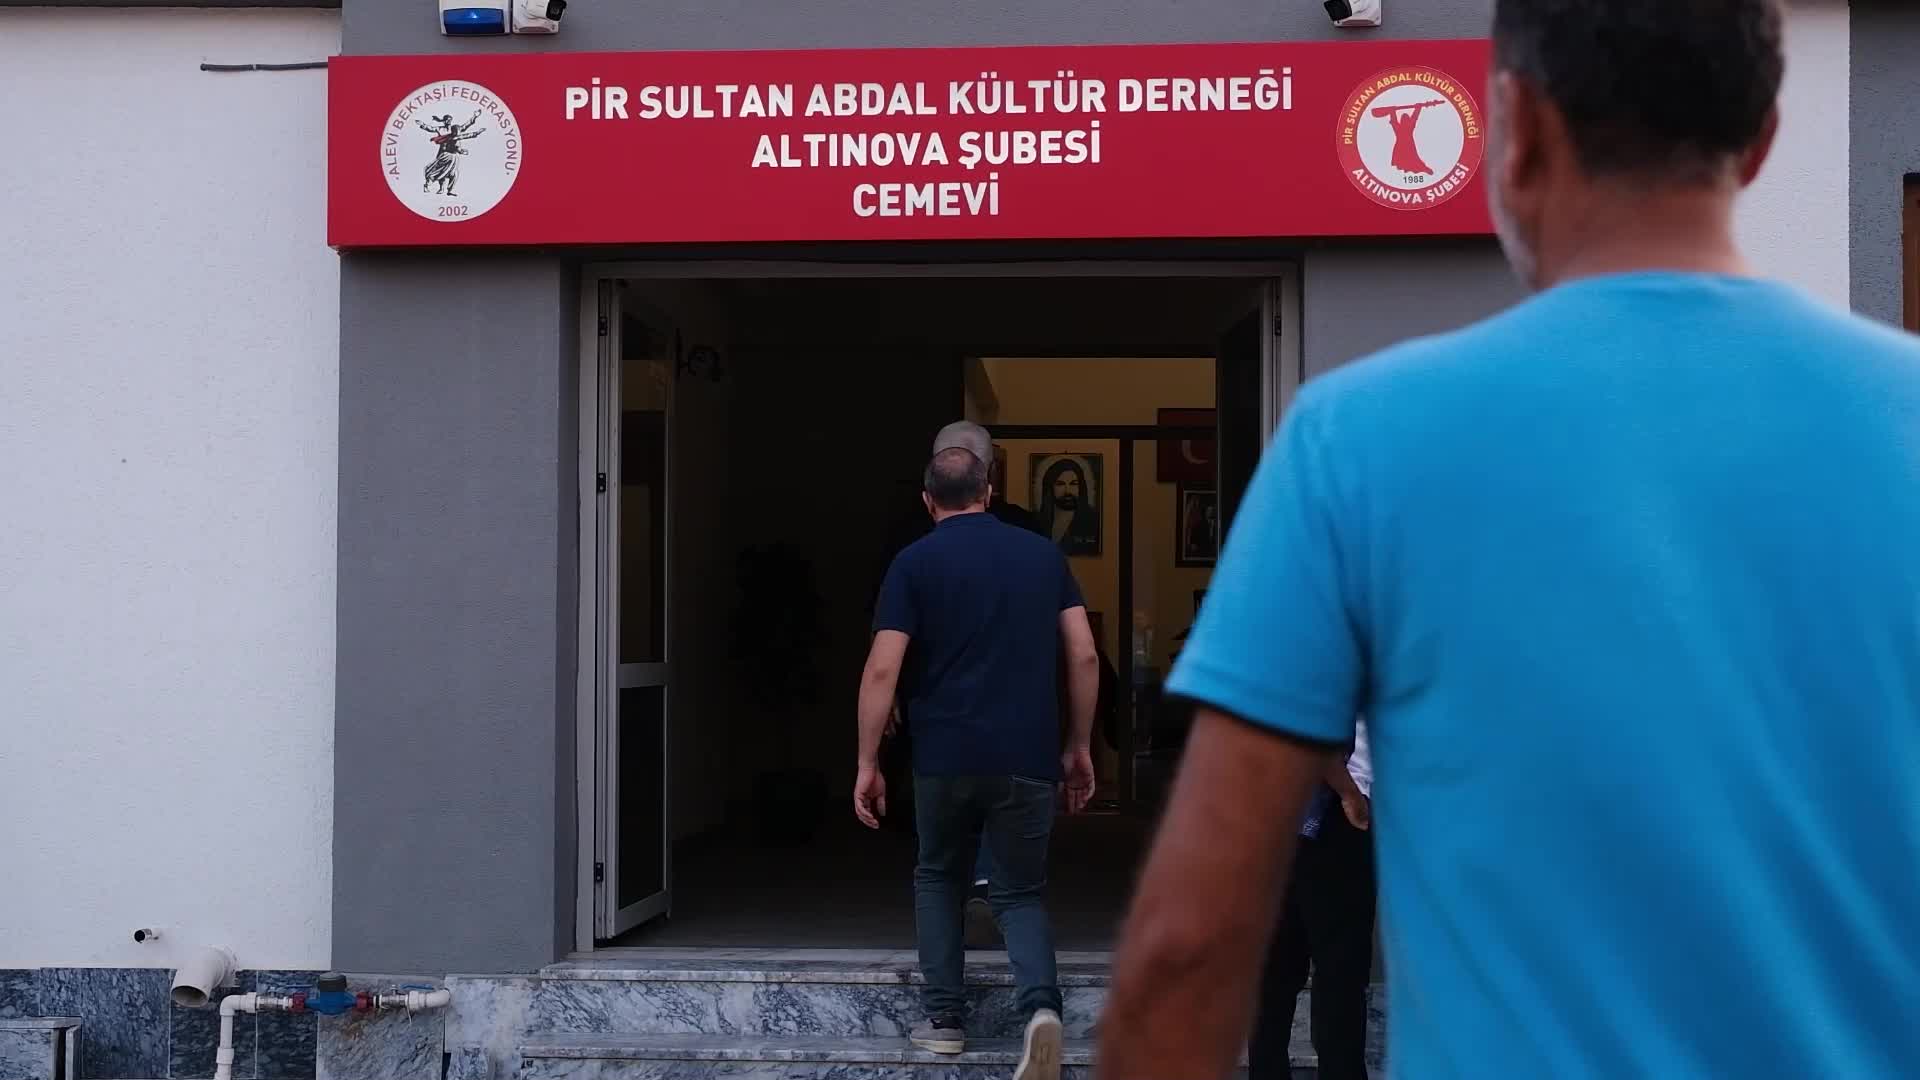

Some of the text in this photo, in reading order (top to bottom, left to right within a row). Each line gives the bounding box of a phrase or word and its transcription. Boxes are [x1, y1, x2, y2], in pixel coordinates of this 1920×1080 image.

[564, 67, 1293, 120] PİR SULTAN ABDAL KÜLTÜR DERNEĞİ
[1342, 72, 1479, 144] PİR SULTAN ABDAL KÜLTÜR DERNEĞİ
[385, 84, 517, 175] ALEVİ BEKTAŞİ FEDERASYONU
[751, 120, 1101, 170] ALTINOVA ŞUBESİ
[853, 172, 999, 218] CEMEVİ
[1352, 163, 1470, 204] ALTINOVA ŞUBESİ
[1403, 176, 1424, 184] 1988
[438, 206, 468, 216] 2002
